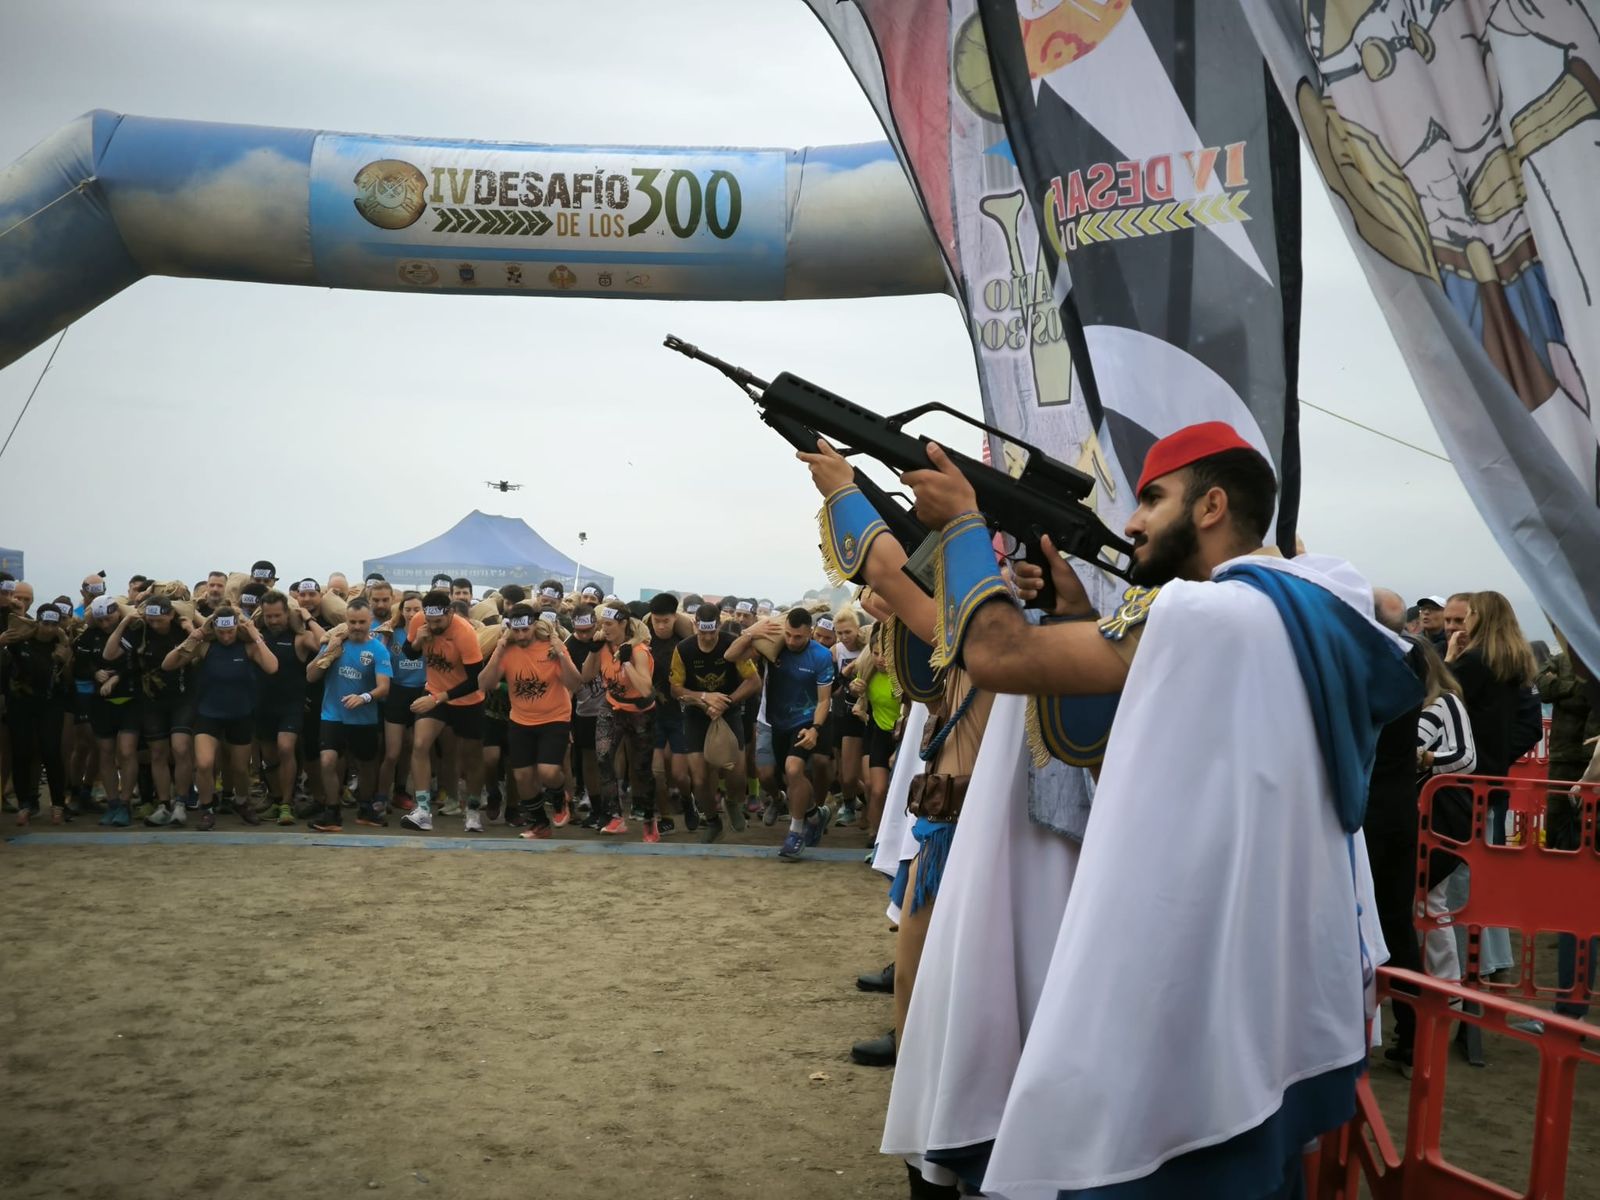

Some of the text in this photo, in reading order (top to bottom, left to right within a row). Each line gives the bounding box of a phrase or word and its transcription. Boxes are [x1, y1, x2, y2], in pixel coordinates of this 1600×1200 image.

[556, 212, 625, 239] DE LOS
[628, 168, 743, 240] 300
